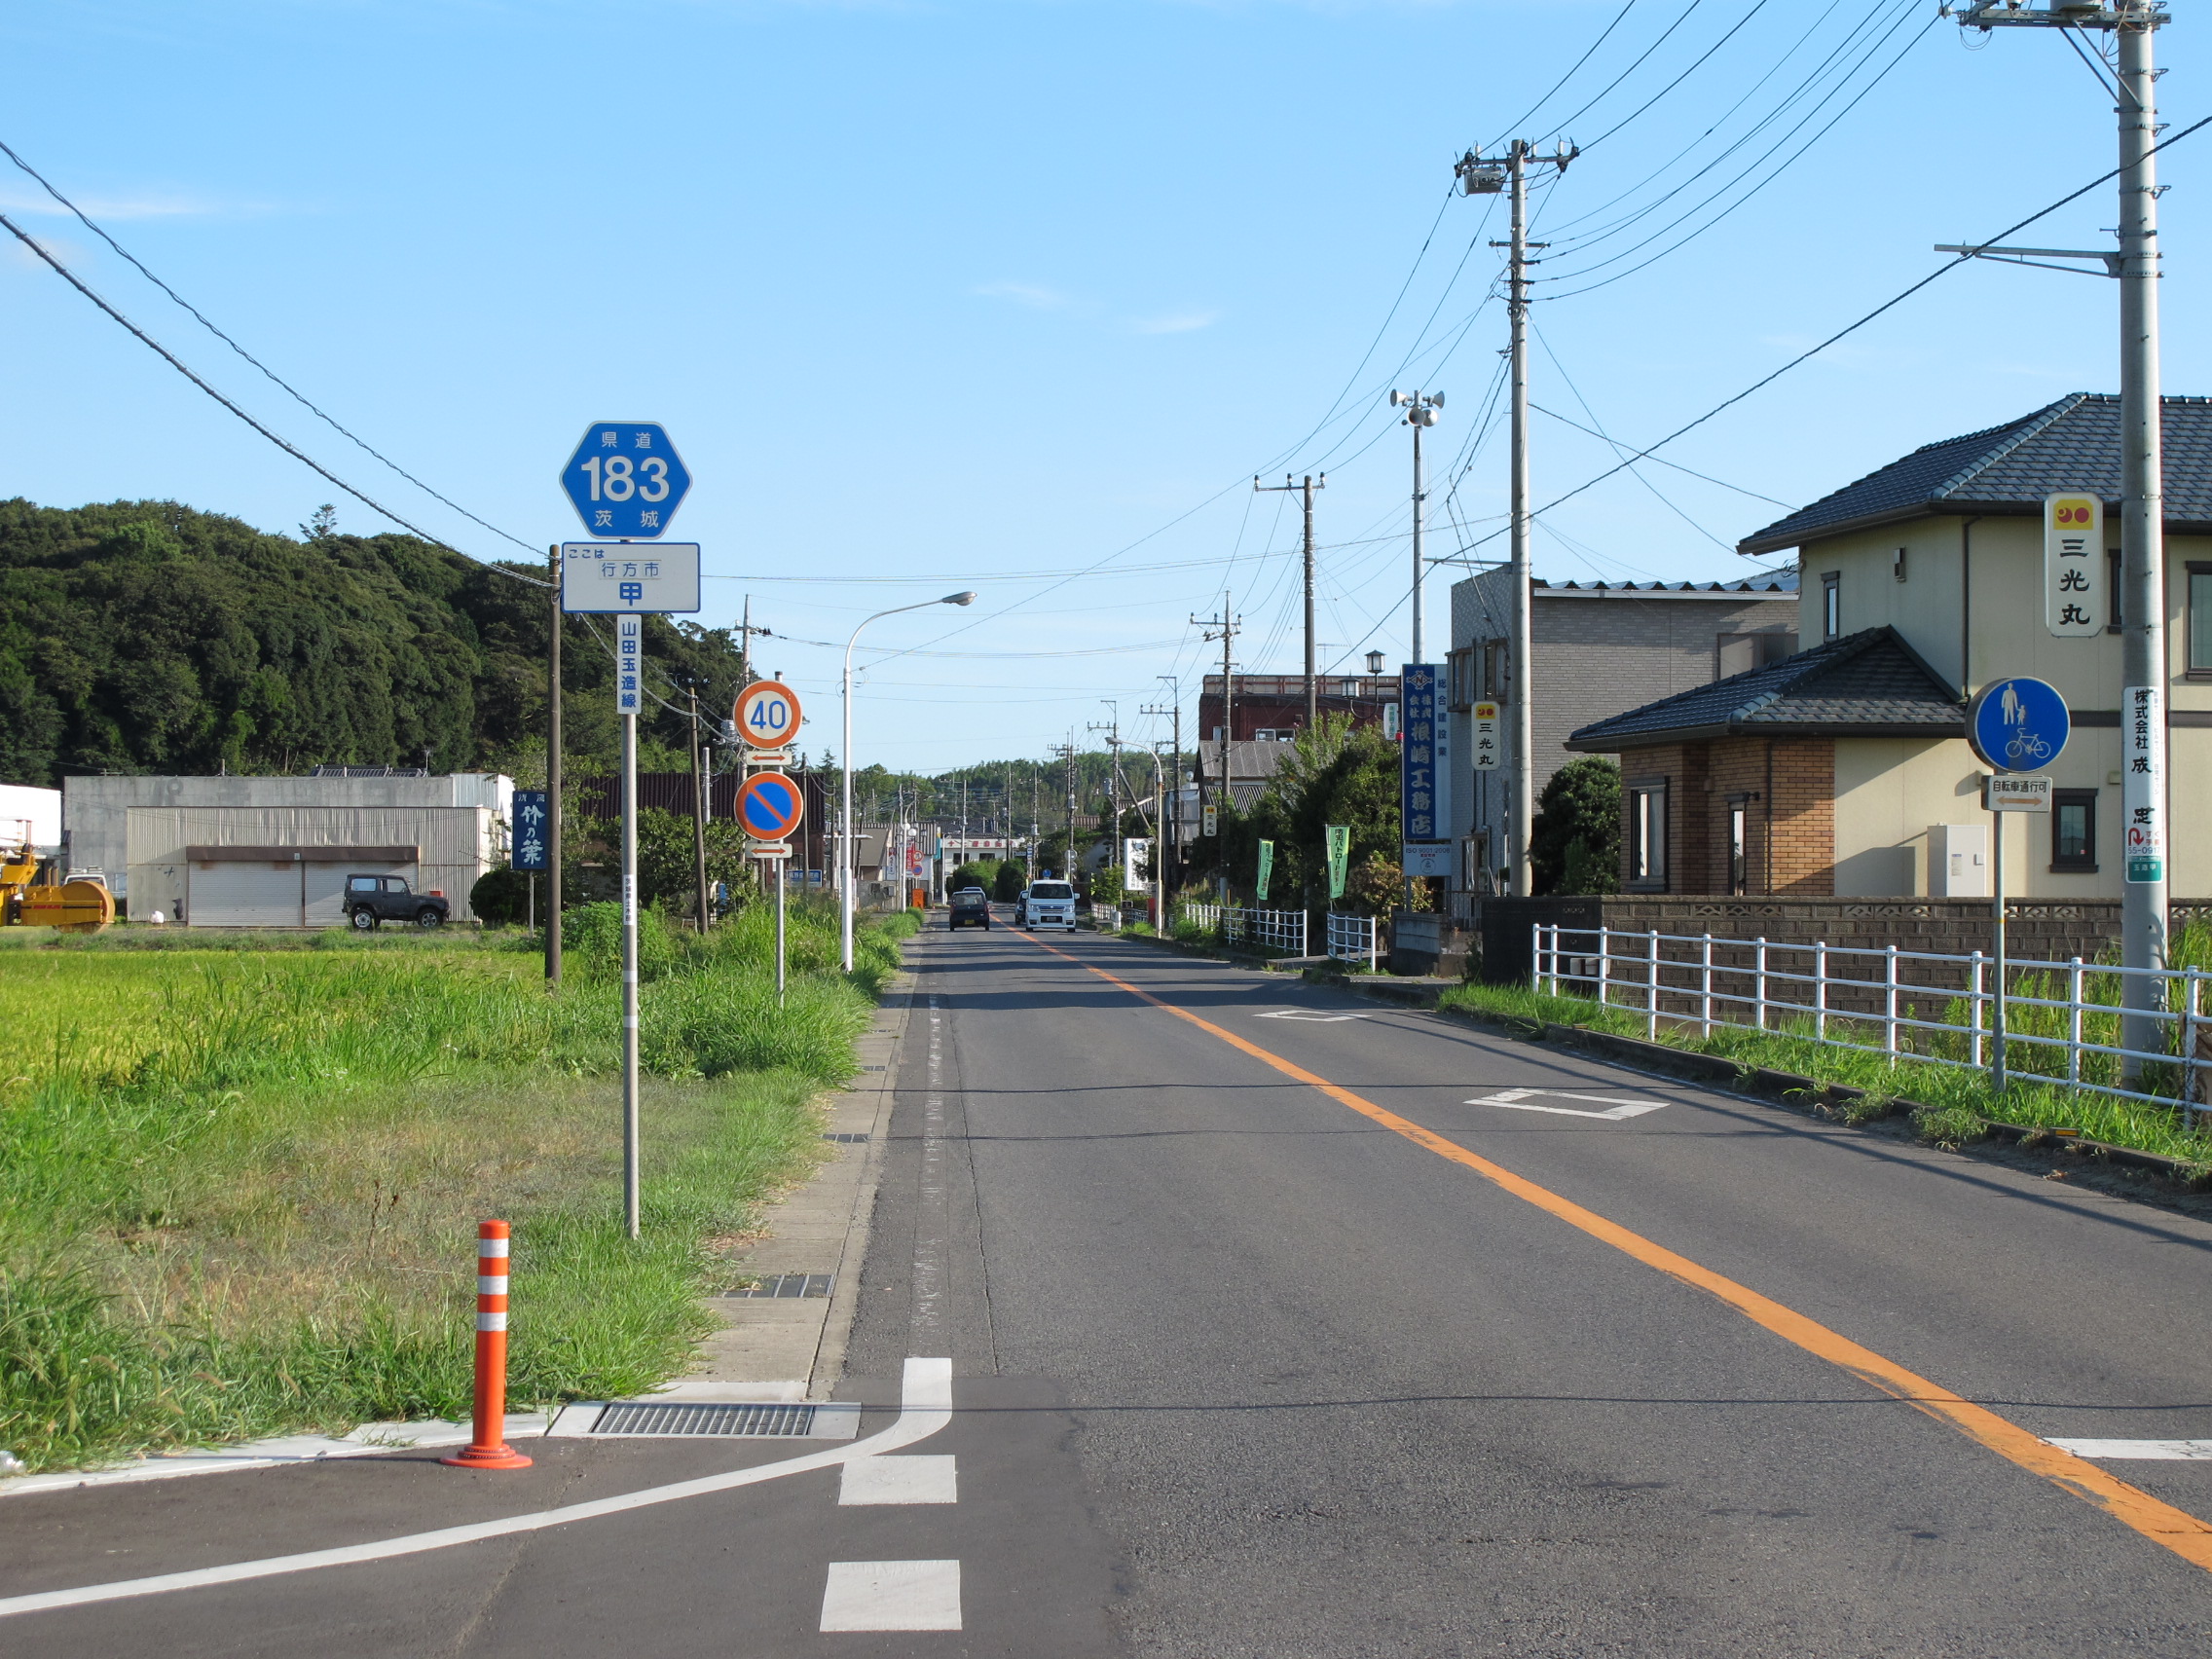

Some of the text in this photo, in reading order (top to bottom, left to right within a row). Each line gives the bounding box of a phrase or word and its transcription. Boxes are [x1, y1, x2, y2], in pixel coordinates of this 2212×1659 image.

[601, 431, 652, 449] 県道
[581, 456, 670, 502] 183
[595, 509, 659, 528] 茨城
[568, 548, 605, 559] ここは
[601, 563, 660, 578] 行方市
[2058, 538, 2090, 626] 三光丸
[619, 582, 643, 607] 甲
[621, 621, 637, 708] 山田玉造線
[750, 700, 786, 729] 40
[2135, 689, 2150, 750] 株式会社
[1478, 723, 1494, 765] 三光丸
[1411, 721, 1431, 835] 根崎工務店
[1993, 780, 2047, 793] 自転車通行可
